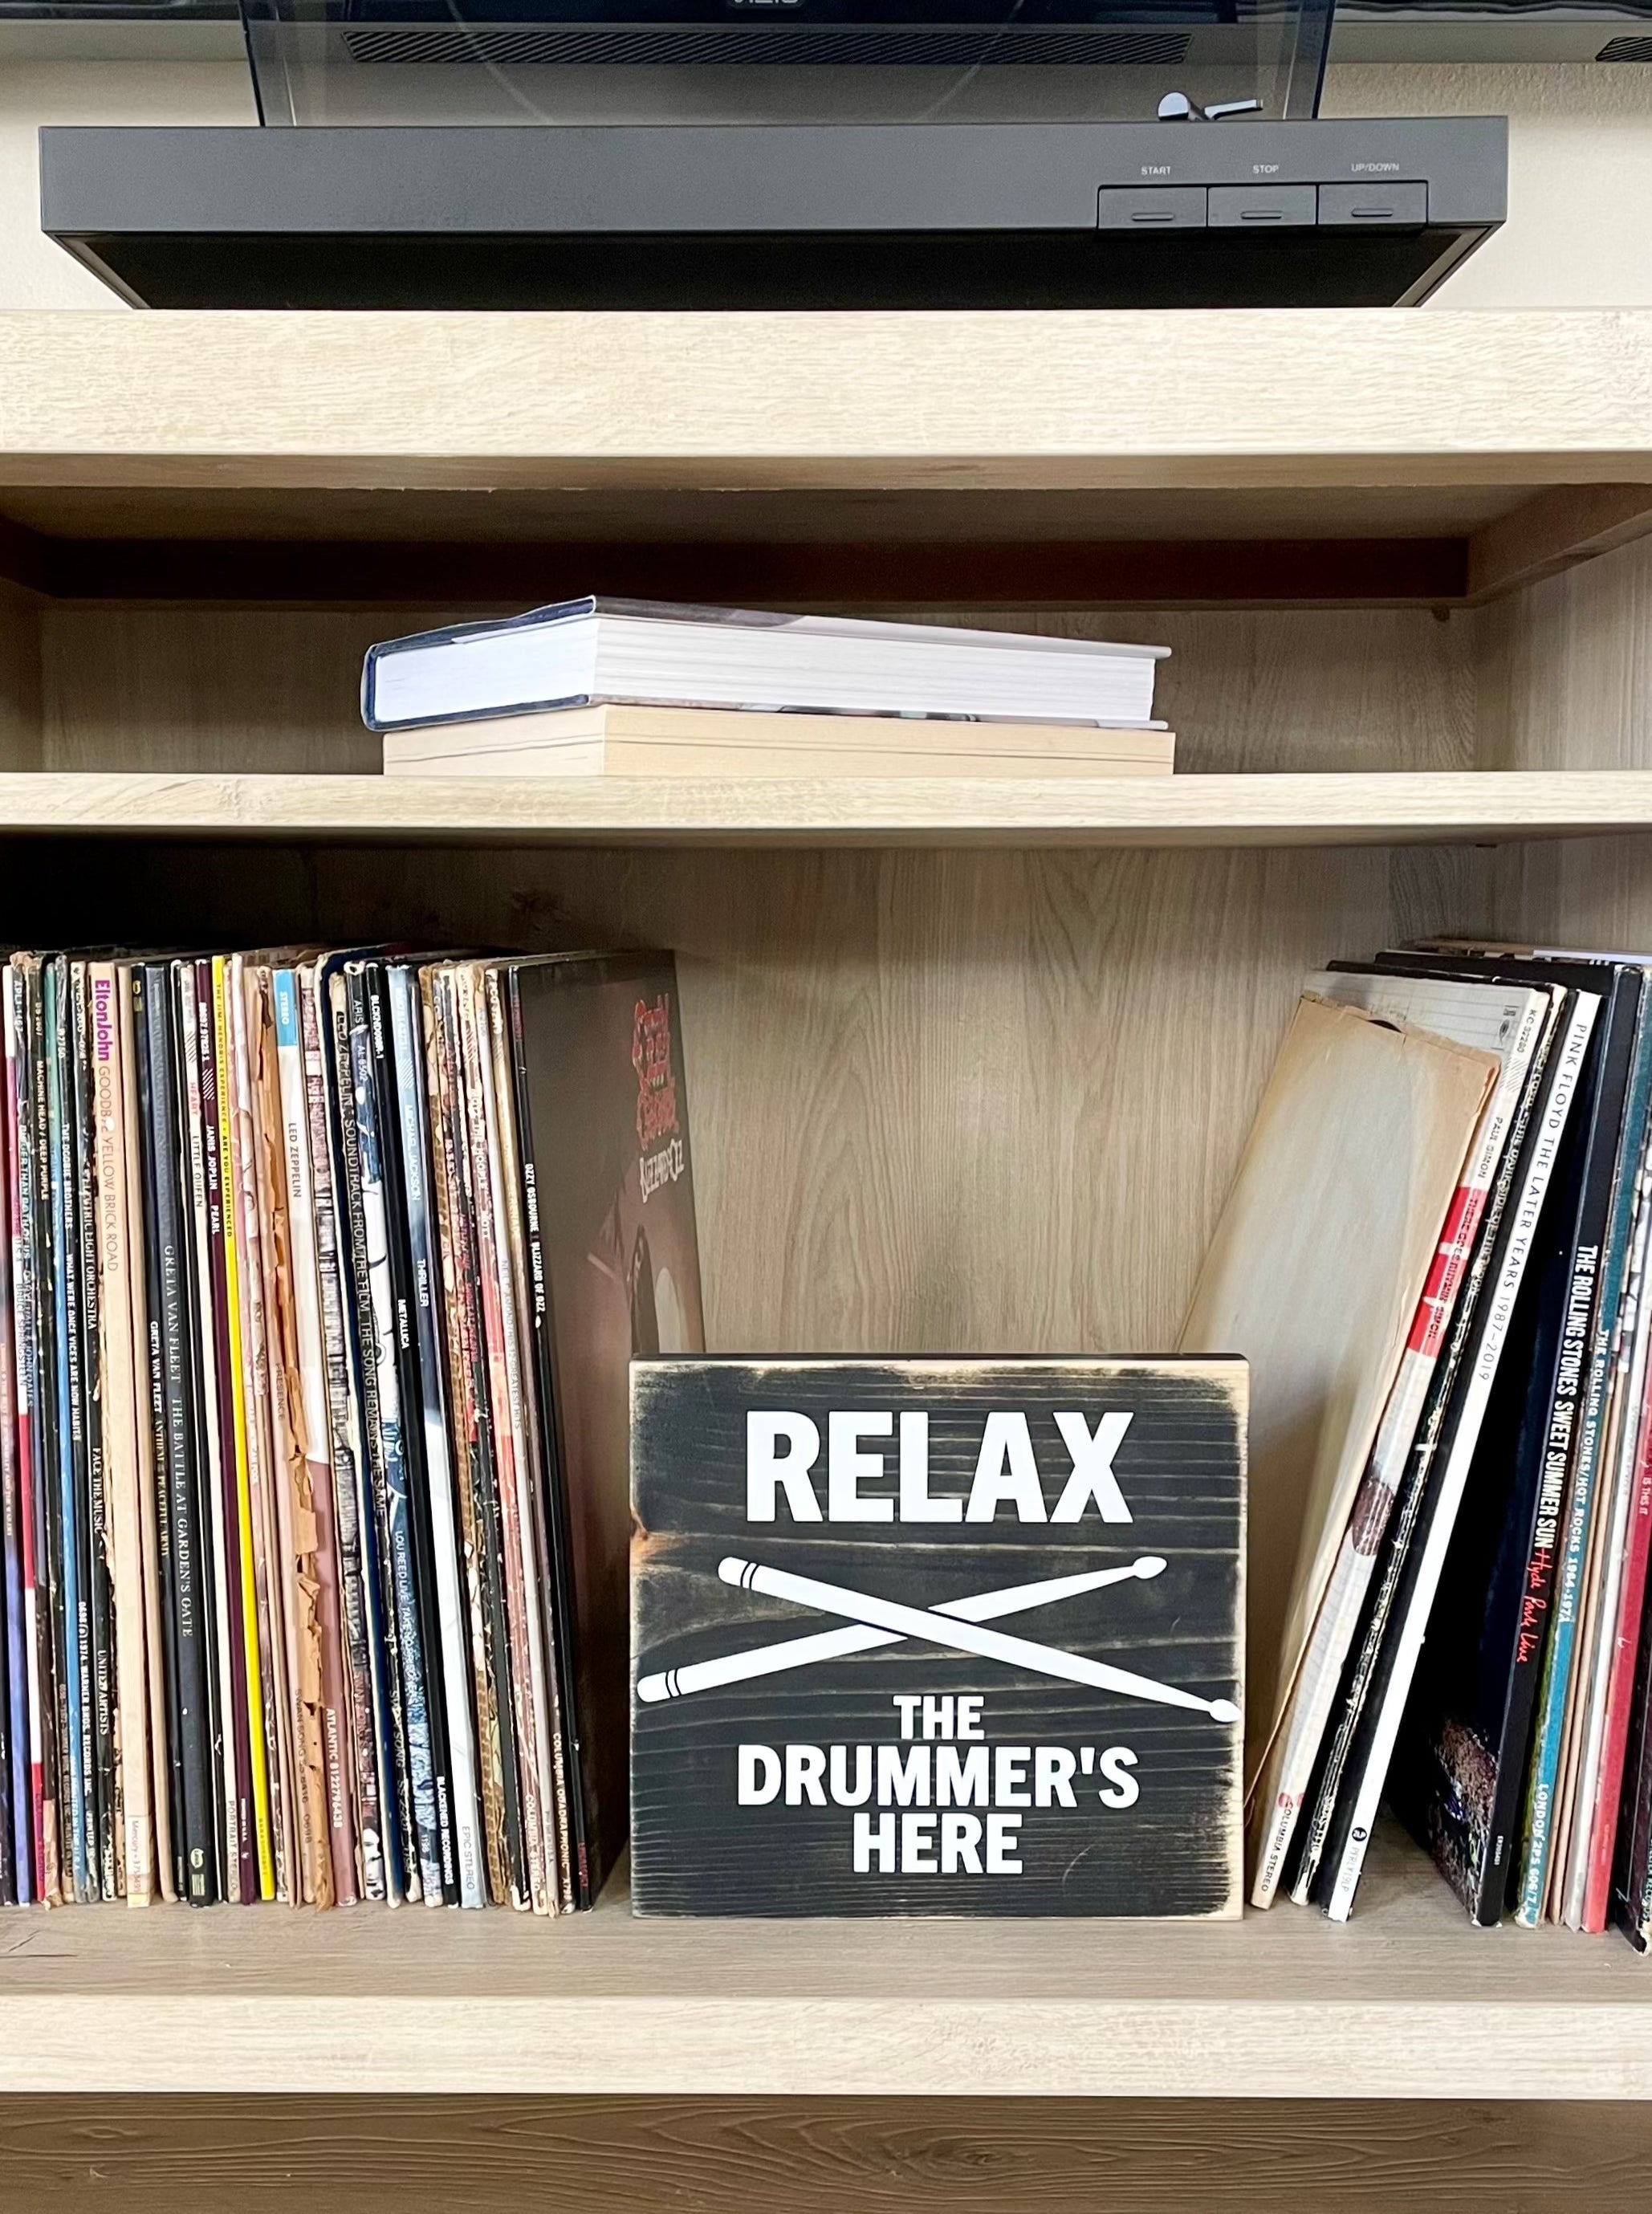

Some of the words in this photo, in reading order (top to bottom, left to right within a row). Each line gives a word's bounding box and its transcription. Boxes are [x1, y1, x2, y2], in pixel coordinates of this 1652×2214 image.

[1141, 166, 1171, 175] START
[1253, 165, 1279, 174] STOP
[1351, 163, 1400, 173] UP/DOWN
[95, 979, 113, 1061] EltonJohn
[280, 991, 289, 1025] STEREO
[1525, 1009, 1538, 1024] KC
[1566, 1023, 1587, 1066] PINK
[36, 1060, 45, 1103] MACHINE
[190, 1082, 199, 1115] HEART
[1548, 1073, 1573, 1128] FLOYD
[206, 1125, 216, 1151] JANIS
[289, 1123, 298, 1142] LED
[405, 1105, 417, 1151] MICHAEL
[1489, 1116, 1503, 1140] PAUL
[63, 1146, 71, 1179] DOOBIE
[102, 1137, 115, 1190] YELLOW
[192, 1136, 202, 1167] LITTLE
[220, 1068, 228, 1123] EXPERIENCE
[224, 1176, 233, 1237] EXPERIENCED
[345, 1119, 361, 1208] SOUNDTRACK
[1478, 1145, 1495, 1178] SIMON
[1536, 1138, 1555, 1168] THE
[20, 1167, 28, 1195] THAN
[40, 1165, 48, 1200] PURPLE
[208, 1155, 218, 1190] JOPLIN
[290, 1146, 301, 1197] ZEPPELIN
[408, 1153, 420, 1201] JACKSON
[525, 1164, 535, 1184] OZZY
[64, 1181, 73, 1229] BROTHERS
[194, 1172, 203, 1207] QUEEN
[1520, 1176, 1544, 1228] LATER
[21, 1197, 29, 1226] BOTH
[104, 1195, 116, 1229] BRICK
[210, 1205, 220, 1234] PEARL
[481, 1210, 490, 1240] MOTT
[526, 1186, 539, 1231] OSBOURNE
[1463, 1198, 1478, 1229] THERE
[22, 1228, 30, 1242] OF
[85, 1231, 95, 1263] LIGHT
[353, 1213, 365, 1249] FROM
[23, 1245, 31, 1259] US
[67, 1254, 75, 1280] WHAT
[106, 1234, 118, 1271] ROAD
[356, 1255, 367, 1277] THE
[531, 1242, 543, 1281] BLIZZARD
[1503, 1237, 1527, 1288] YEARS
[1575, 1245, 1598, 1273] THE
[164, 1245, 177, 1296] GRETA
[417, 1258, 429, 1306] THRILLER
[501, 1260, 510, 1279] NEIL
[16, 1284, 24, 1316] BRUCE
[68, 1282, 76, 1308] WERE
[86, 1266, 96, 1329] ORCHESTRA
[359, 1282, 370, 1312] FILM
[534, 1283, 544, 1294] OF
[535, 1296, 545, 1312] OZZ
[68, 1310, 77, 1333] ONCE
[167, 1302, 179, 1331] VAN
[1565, 1275, 1593, 1337] ROLLING
[151, 1321, 160, 1355] GRETA
[361, 1320, 373, 1346] THE
[397, 1299, 410, 1349] METALLICA
[17, 1319, 26, 1386] SPRINGSTEEN
[69, 1336, 78, 1362] VICES
[1595, 1329, 1609, 1355] THE
[70, 1365, 79, 1383] ARE
[152, 1359, 161, 1378] VAN
[168, 1337, 181, 1384] FLEET
[364, 1349, 376, 1386] SONG
[1556, 1339, 1584, 1396] STONES
[71, 1386, 80, 1404] NOW
[153, 1382, 163, 1413] FLEET
[509, 1358, 520, 1406] GREATEST
[1588, 1359, 1605, 1416] ROLLING
[72, 1408, 81, 1441] HABITS
[171, 1398, 183, 1427] THE
[366, 1390, 380, 1448] REMAINS
[513, 1409, 522, 1429] HITS
[1549, 1401, 1575, 1451] SWEET
[155, 1420, 165, 1460] ANTHEM
[93, 1448, 102, 1475] FACE
[173, 1433, 186, 1488] BATTLE
[371, 1453, 381, 1475] THE
[746, 1411, 1135, 1523] RELAX
[1575, 1420, 1596, 1504] STONES/HOT
[94, 1477, 102, 1498] THE
[157, 1476, 168, 1524] PEACEFUL
[373, 1481, 384, 1516] SAME
[1539, 1452, 1567, 1515] SUMMER
[1640, 1488, 1650, 1505] THIS
[94, 1500, 103, 1533] MUSIC
[176, 1494, 187, 1514] AT
[160, 1530, 169, 1558] ARMY
[395, 1531, 405, 1550] LOU
[1534, 1518, 1556, 1548] SUN
[1570, 1508, 1585, 1552] ROCKS
[177, 1519, 191, 1592] GARDEN'S
[396, 1551, 408, 1578] REED
[1526, 1548, 1553, 1589] Hyde
[399, 1580, 410, 1600] LIVE
[181, 1597, 193, 1637] GATE
[401, 1606, 412, 1630] TAKE
[1520, 1595, 1546, 1626] Park
[81, 1666, 90, 1703] WARNER
[98, 1650, 107, 1690] UNITED
[82, 1706, 90, 1730] BROS.
[99, 1693, 108, 1735] ARTISTS
[295, 1689, 305, 1722] SWAN
[893, 1695, 985, 1740] THE
[297, 1726, 307, 1755] SONG
[326, 1708, 338, 1759] ATLANTIC
[392, 1732, 404, 1767] SONG
[83, 1735, 92, 1775] RECORDS
[553, 1732, 565, 1786] COLUMBIA
[84, 1779, 92, 1796] INC.
[396, 1779, 406, 1796] SS
[738, 1745, 1139, 1808] DRUMMER'S
[329, 1763, 342, 1828] 8122796438
[437, 1776, 449, 1827] BLACKENED
[1532, 1783, 1549, 1839] LONDON
[131, 1820, 139, 1851] Mercury
[227, 1801, 237, 1849] PORTRAIT
[303, 1814, 312, 1844] 0698
[462, 1826, 472, 1849] EPIC
[526, 1795, 537, 1846] COLUMBIA
[556, 1788, 570, 1868] QUADRAPHONIC
[1273, 1803, 1293, 1851] COLUMBIA
[441, 1829, 454, 1884] RECORDINGS
[853, 1813, 1023, 1874] HERE
[1531, 1840, 1543, 1866] 2PS
[229, 1852, 238, 1890] STEREO
[463, 1851, 474, 1889] STEREO
[1261, 1855, 1278, 1892] STEREO
[1527, 1868, 1540, 1904] 606/7
